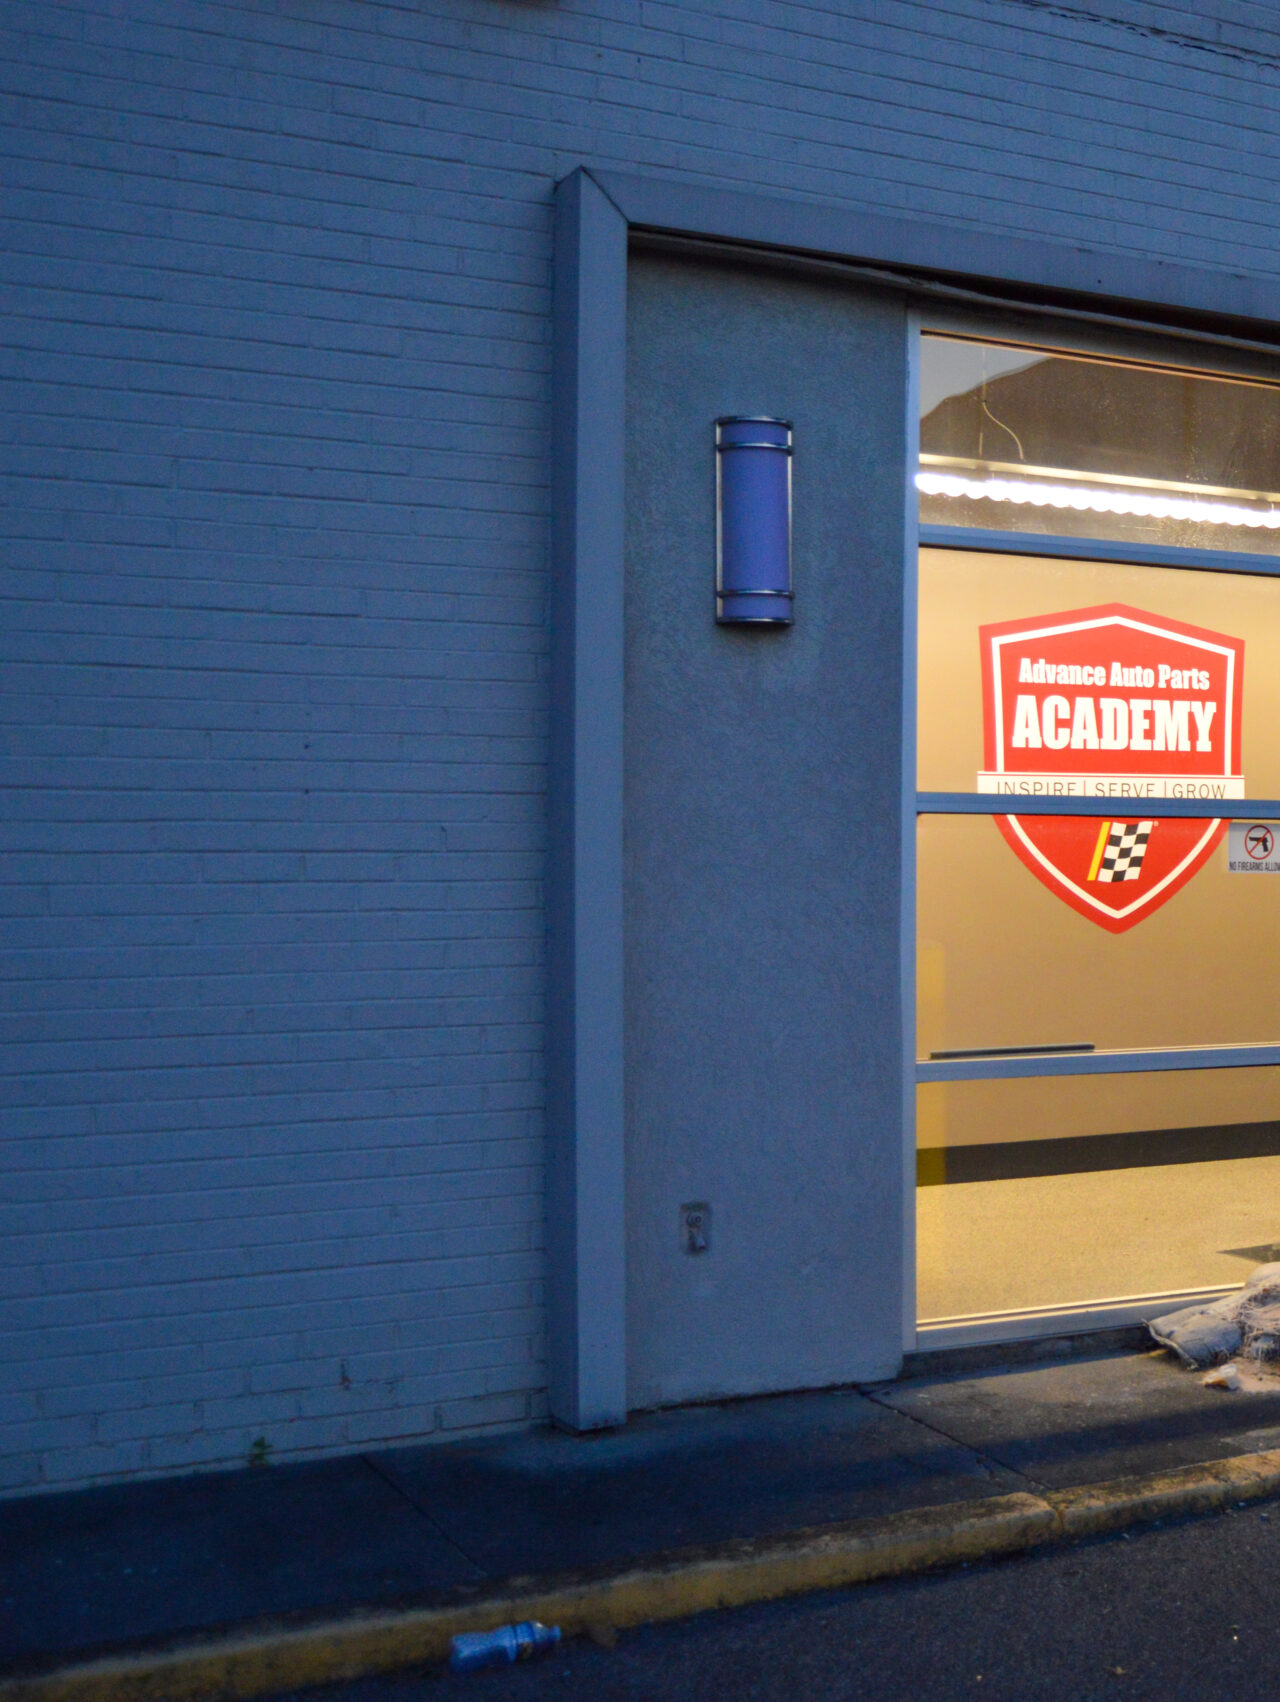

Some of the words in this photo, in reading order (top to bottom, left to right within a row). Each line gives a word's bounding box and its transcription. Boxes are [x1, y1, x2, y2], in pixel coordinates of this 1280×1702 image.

[1019, 658, 1106, 686] Advance
[1110, 662, 1155, 688] Auto
[1158, 664, 1210, 690] Parts
[1012, 694, 1216, 752] ACADEMY
[1172, 783, 1226, 799] GROW
[1229, 861, 1237, 871] NO
[1238, 861, 1264, 871] FIREARMS
